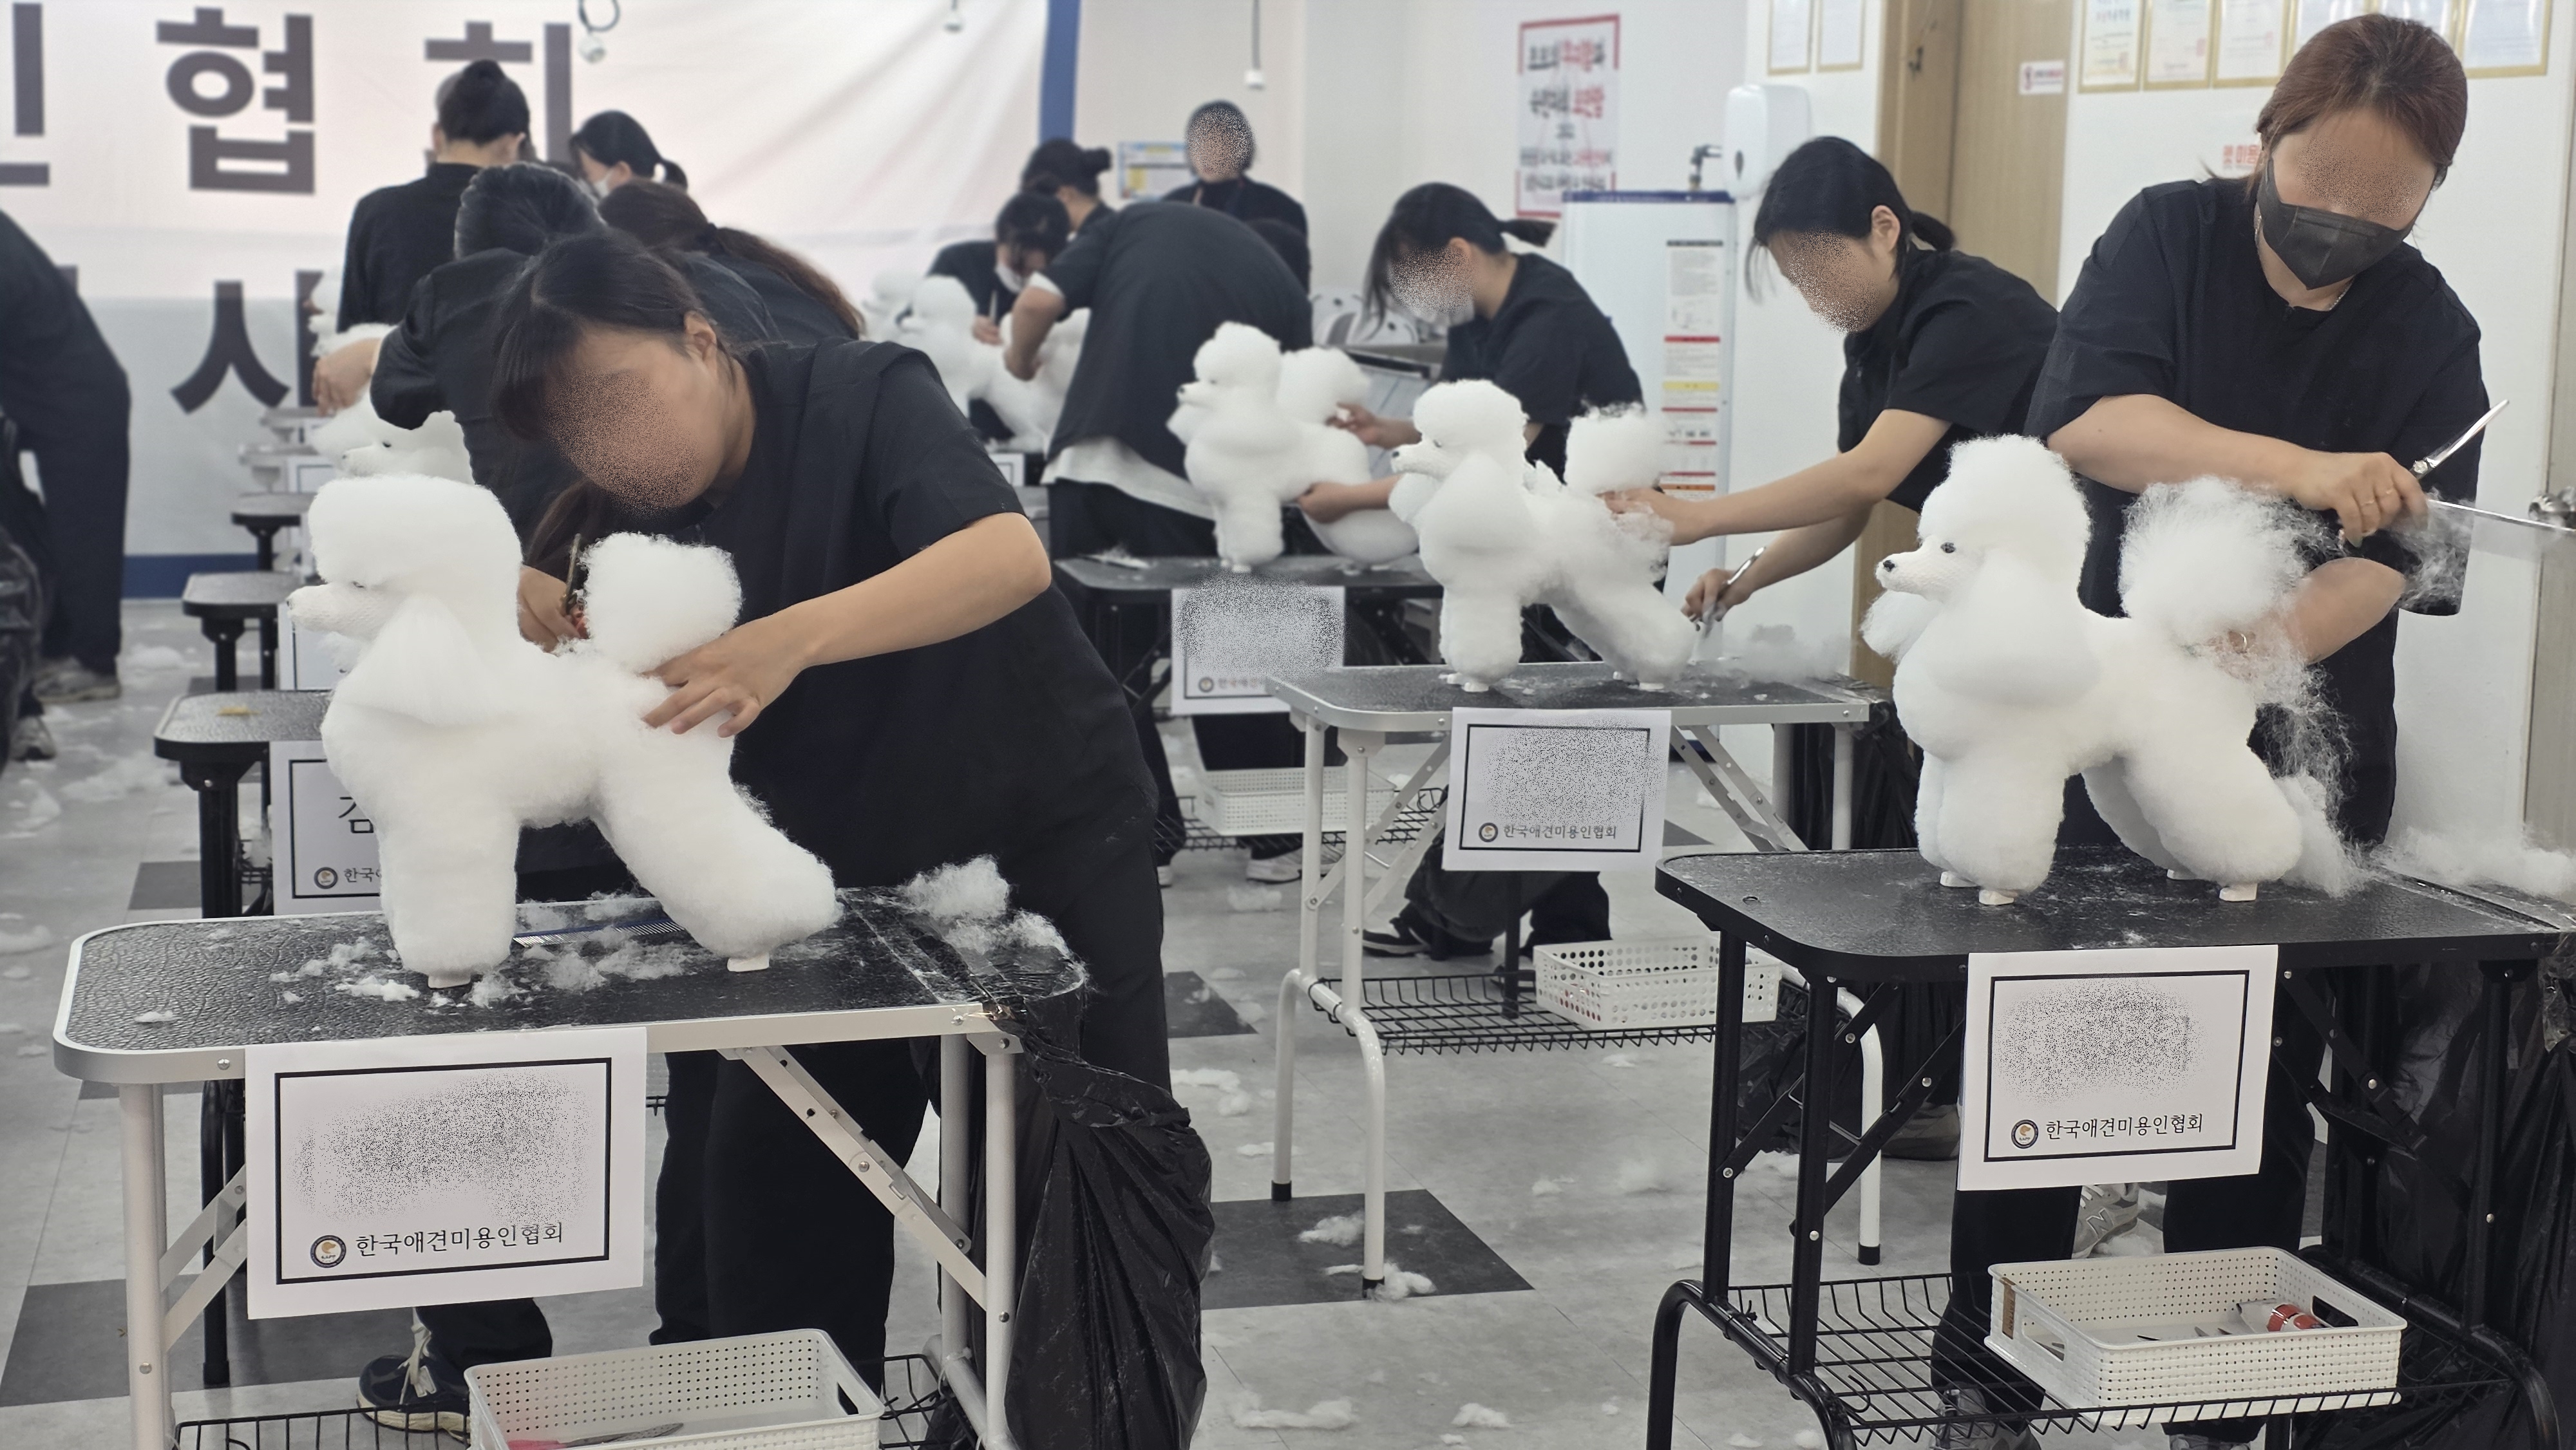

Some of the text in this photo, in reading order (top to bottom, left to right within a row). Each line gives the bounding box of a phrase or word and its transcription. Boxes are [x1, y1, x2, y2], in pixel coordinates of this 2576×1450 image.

[1503, 824, 1617, 840] 한국애견미용인협회
[2045, 1113, 2203, 1140] 한국애견미용인협회
[355, 1221, 564, 1257] 한국애견미용인협회
